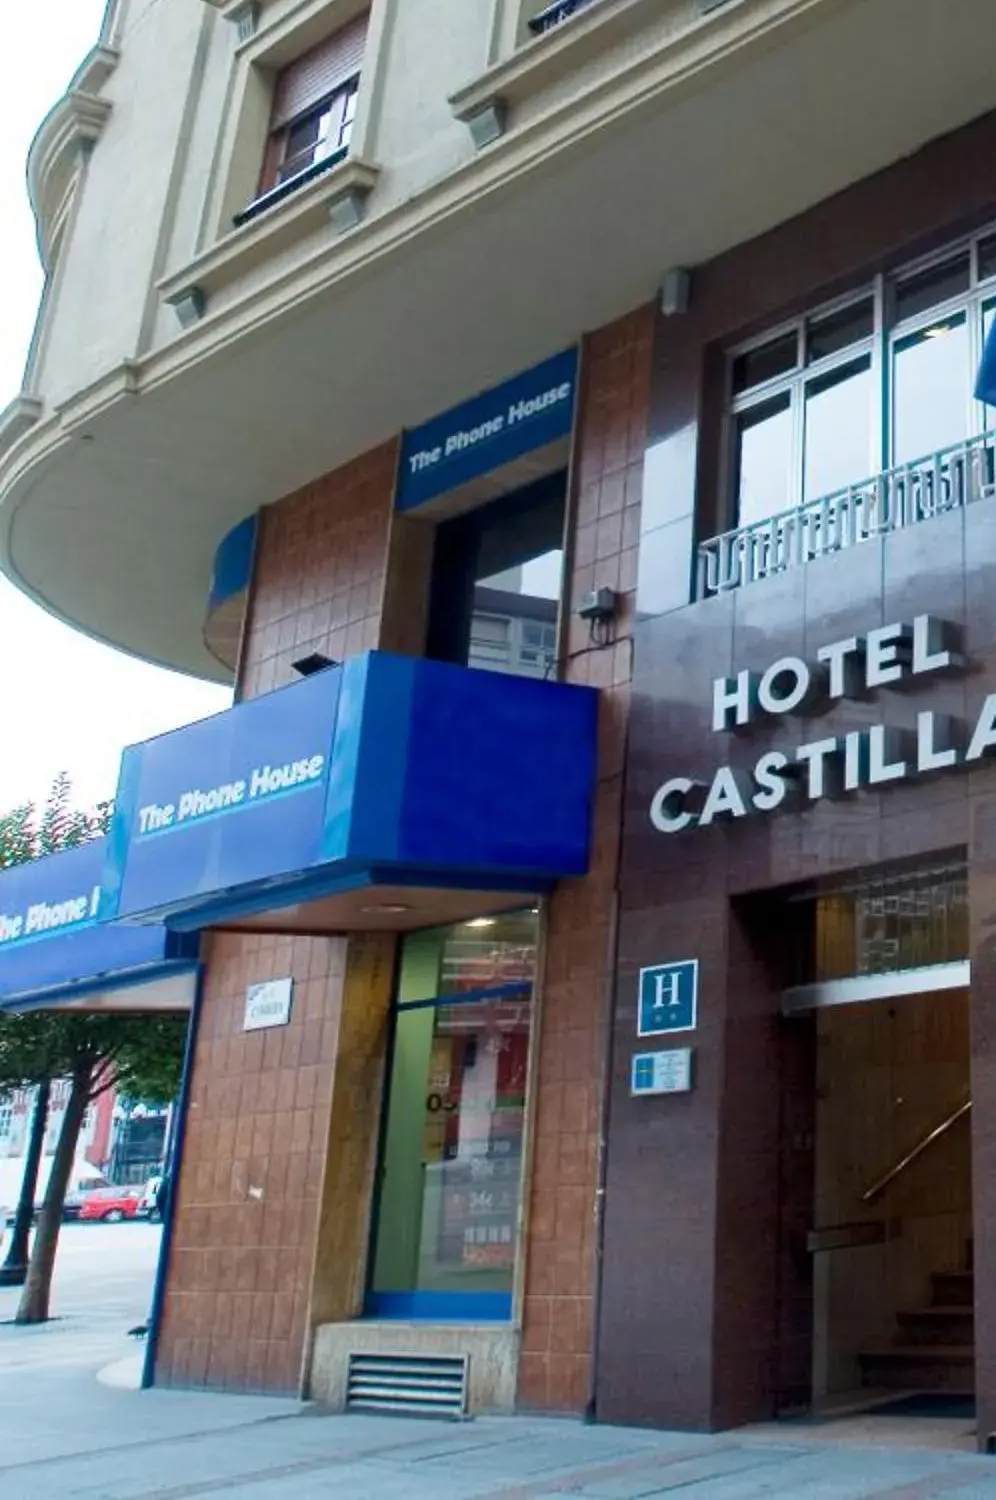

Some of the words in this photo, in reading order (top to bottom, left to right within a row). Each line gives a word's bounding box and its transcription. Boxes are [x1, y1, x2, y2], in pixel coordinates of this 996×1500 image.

[409, 446, 442, 474] The
[444, 414, 505, 456] Phone
[507, 381, 571, 425] House
[712, 614, 951, 732] HOTEL
[139, 803, 175, 833] The
[177, 780, 247, 821] Phone
[249, 754, 325, 797] House
[0, 914, 22, 941] he
[24, 896, 87, 935] Phone
[652, 971, 683, 1009] H
